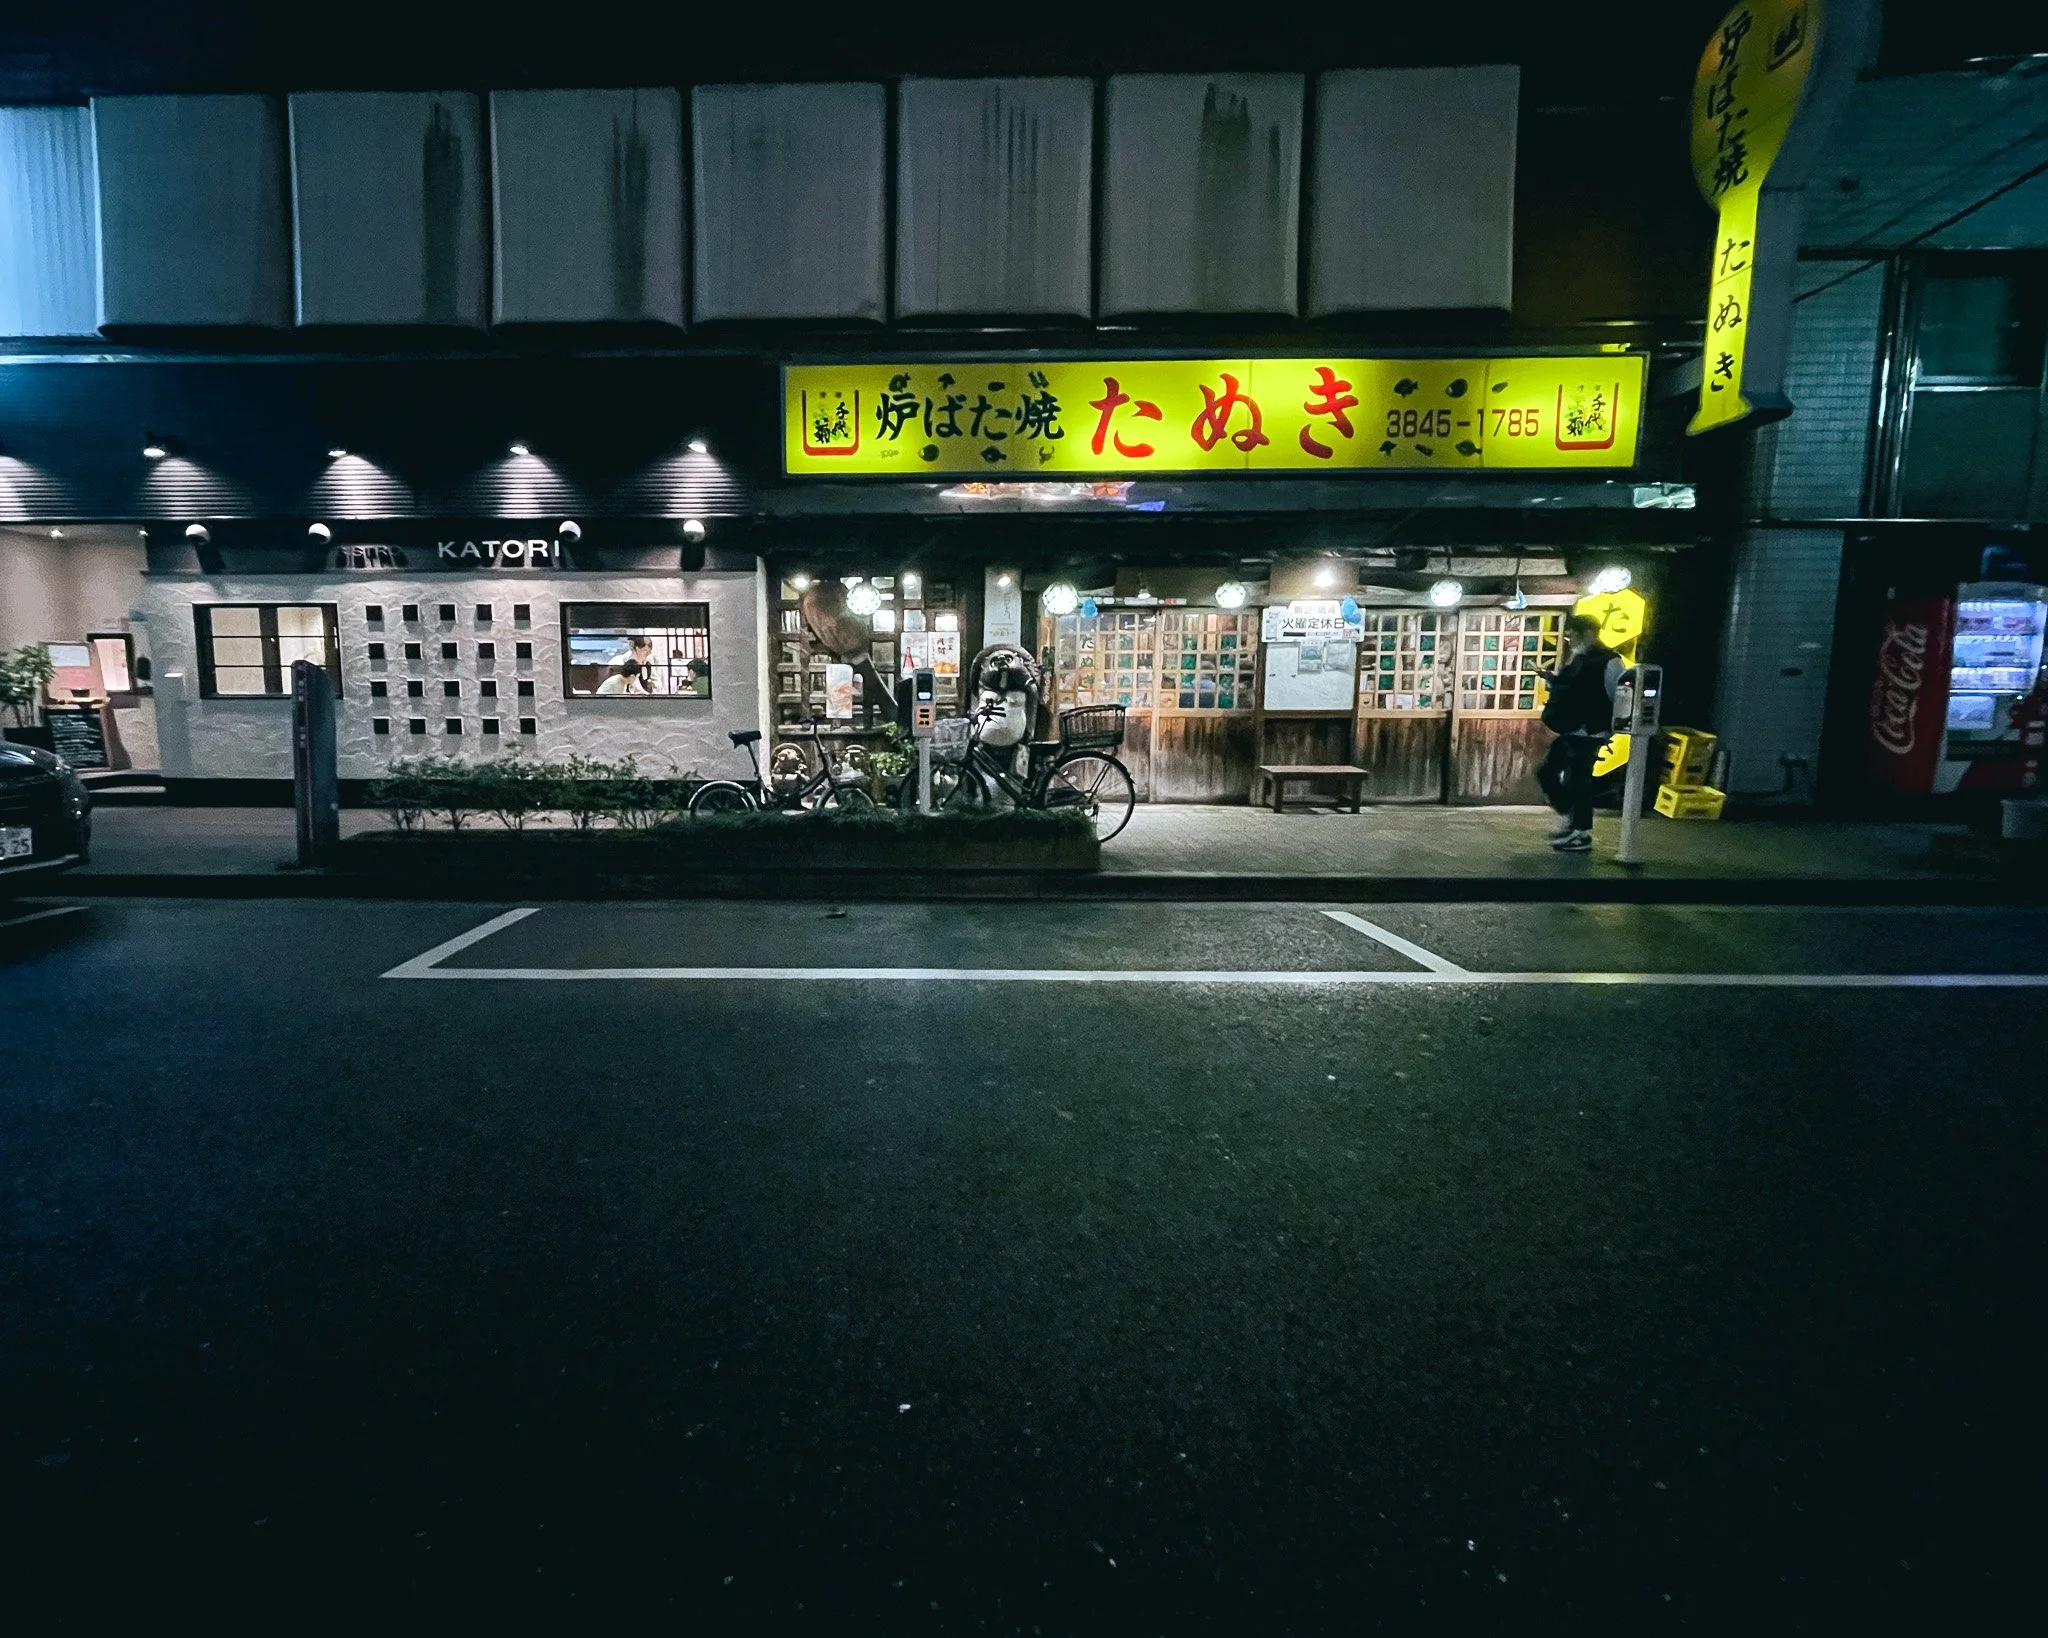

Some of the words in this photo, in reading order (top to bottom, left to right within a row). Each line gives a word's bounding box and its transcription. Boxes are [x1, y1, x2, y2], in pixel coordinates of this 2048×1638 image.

[1711, 238, 1750, 392] たぬき
[875, 392, 1065, 440] 炉ばた焼
[1088, 366, 1359, 459] たぬき
[1386, 408, 1540, 438] 3845-1785
[437, 539, 560, 559] KATORI
[1282, 617, 1345, 630] 火曜定休日
